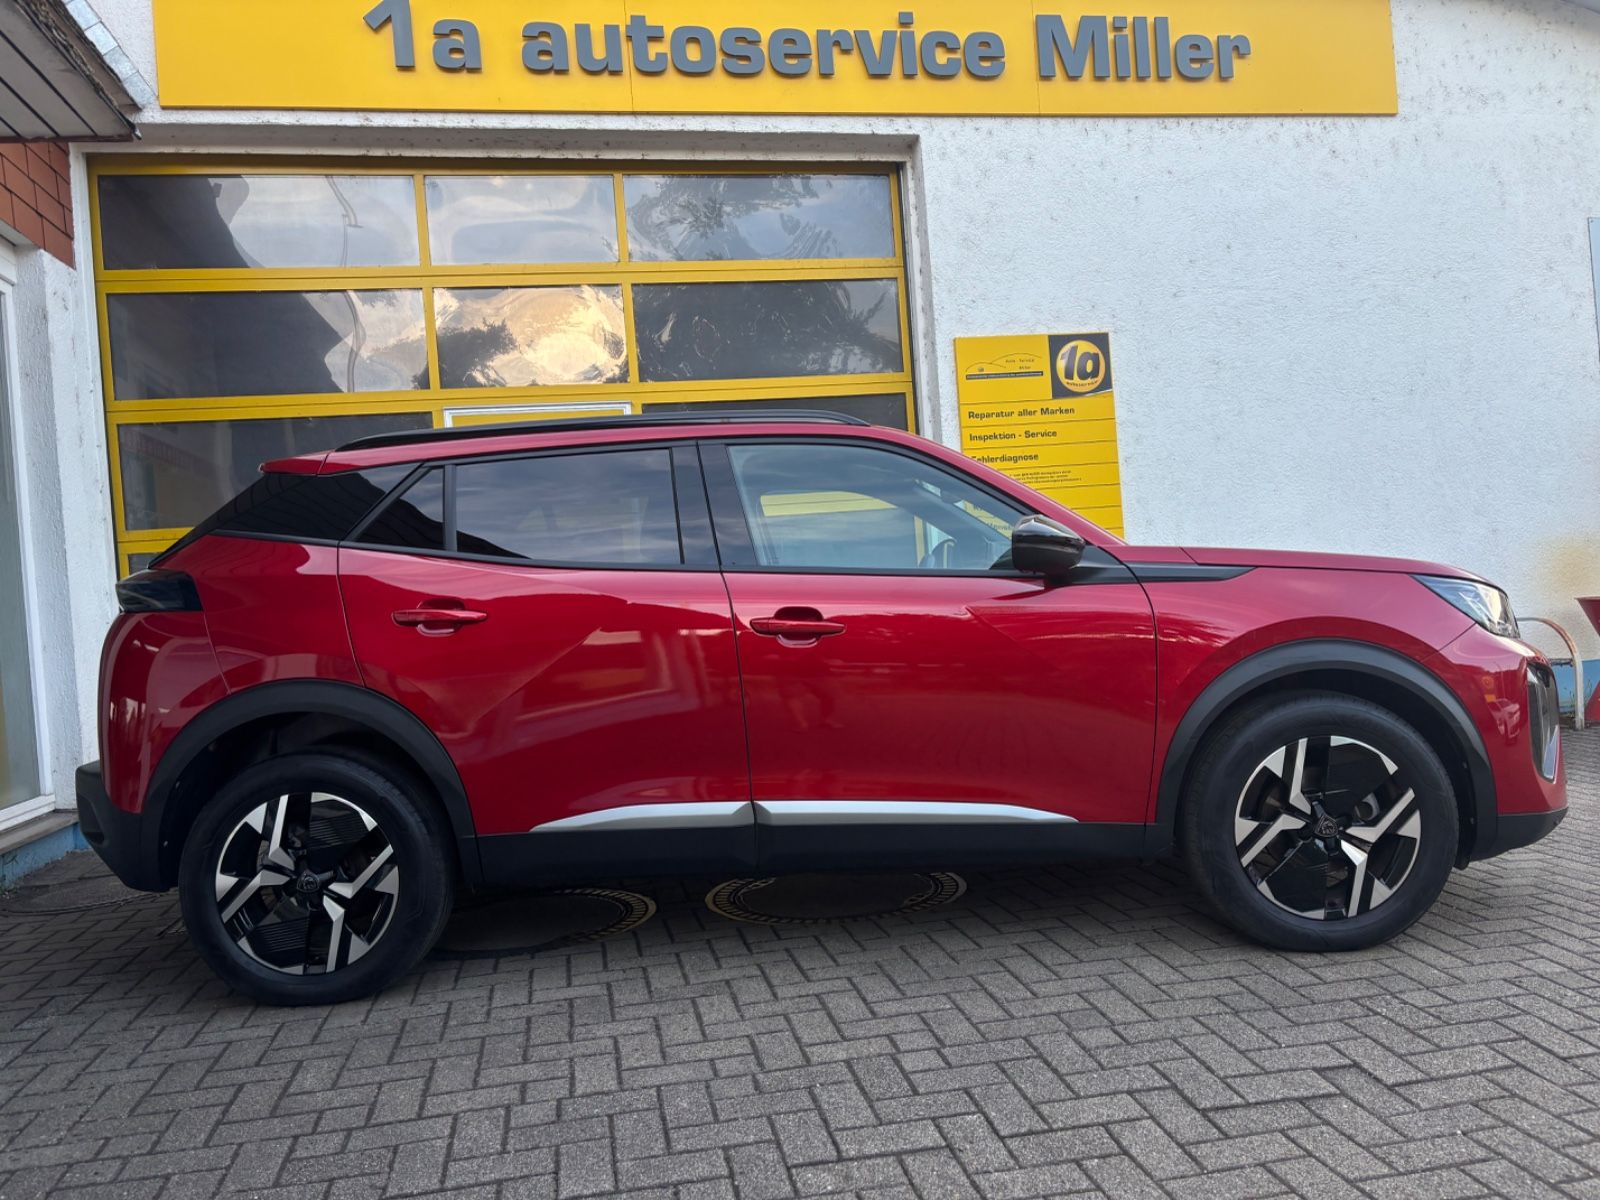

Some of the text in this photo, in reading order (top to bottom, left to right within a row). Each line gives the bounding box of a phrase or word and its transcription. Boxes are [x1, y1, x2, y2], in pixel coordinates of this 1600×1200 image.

[362, 0, 1252, 81] 1a autoservice Miller
[1060, 344, 1100, 381] 1a
[968, 407, 1075, 420] Reparatur aller Marken
[969, 432, 1016, 442] Inspektion
[1024, 430, 1057, 439] Service
